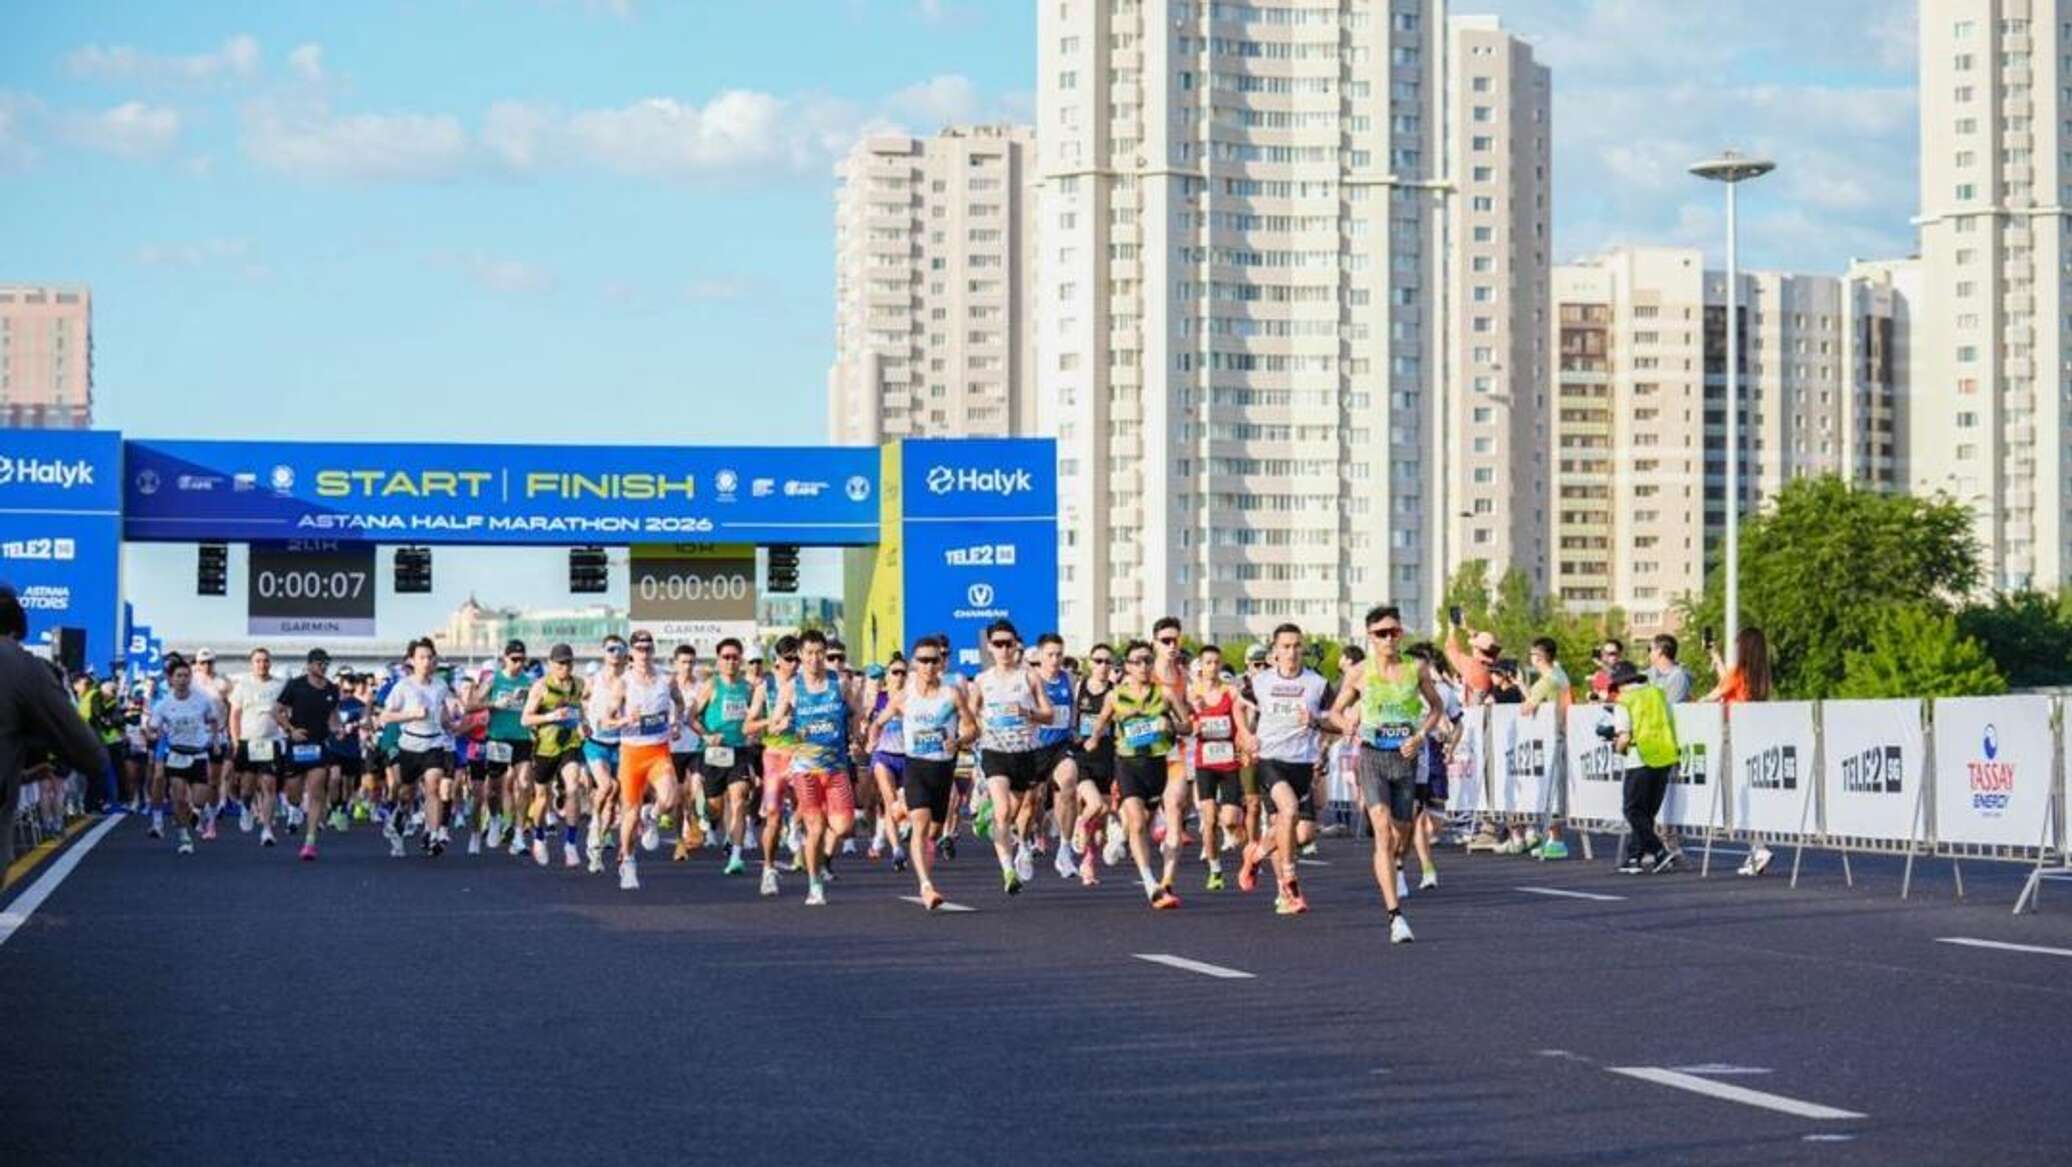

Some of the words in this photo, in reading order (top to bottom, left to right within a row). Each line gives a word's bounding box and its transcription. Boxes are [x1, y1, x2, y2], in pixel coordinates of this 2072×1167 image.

[17, 458, 94, 489] Halyk
[315, 470, 494, 497] START
[526, 473, 695, 499] FINISH
[958, 467, 1033, 496] Halyk
[297, 514, 406, 529] ASTANA
[411, 515, 484, 530] HALF
[488, 516, 640, 532] MARATHON
[645, 517, 714, 533] 2026
[2, 539, 53, 560] TELE2
[944, 545, 994, 566] TELE2
[24, 586, 70, 596] ASTANA
[257, 570, 367, 599] 0:00:07
[640, 574, 747, 601] 0:00:00
[280, 621, 340, 633] GARMIN
[663, 623, 722, 635] GARMIN
[1745, 746, 1781, 788] TELE2
[1841, 746, 1884, 793] TELE2
[1967, 762, 2016, 792] TASSAY
[1973, 794, 2011, 810] ENERGY
